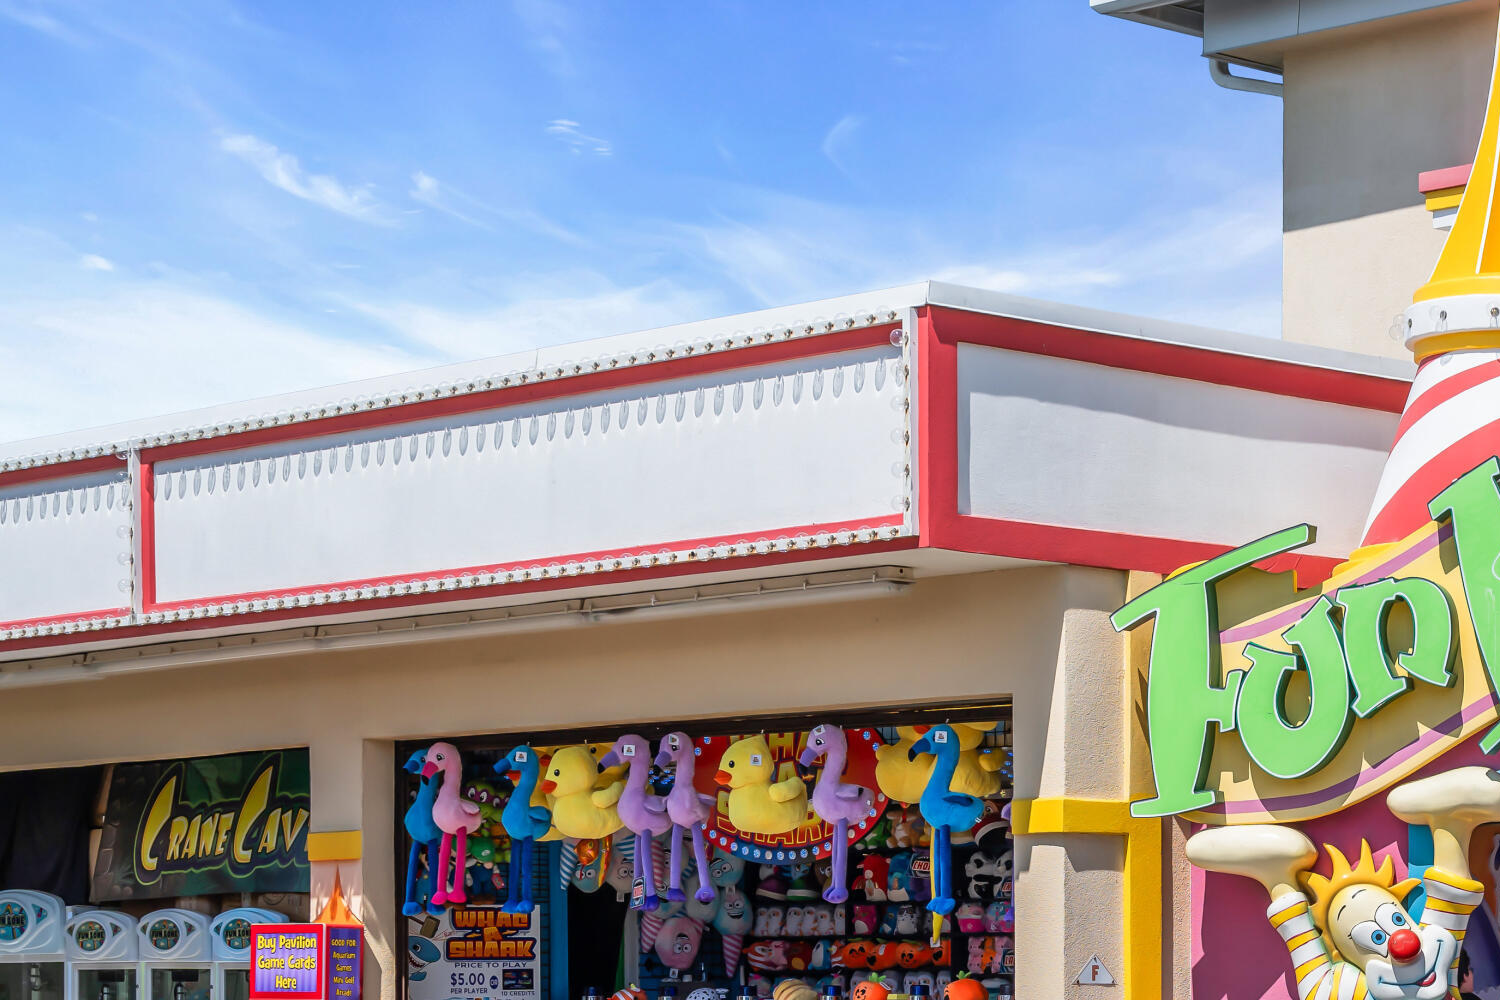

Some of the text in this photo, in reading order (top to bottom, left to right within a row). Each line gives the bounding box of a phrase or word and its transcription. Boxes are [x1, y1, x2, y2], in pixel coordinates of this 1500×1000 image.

[141, 765, 309, 870] CRANE CAV
[455, 910, 529, 928] WHAC
[483, 926, 503, 941] A
[257, 935, 317, 953] Buy Pavilion
[448, 940, 534, 958] SHARK
[258, 954, 316, 970] Game Cards
[450, 972, 485, 987] $5.00
[1092, 965, 1100, 981] F
[275, 975, 297, 989] Here
